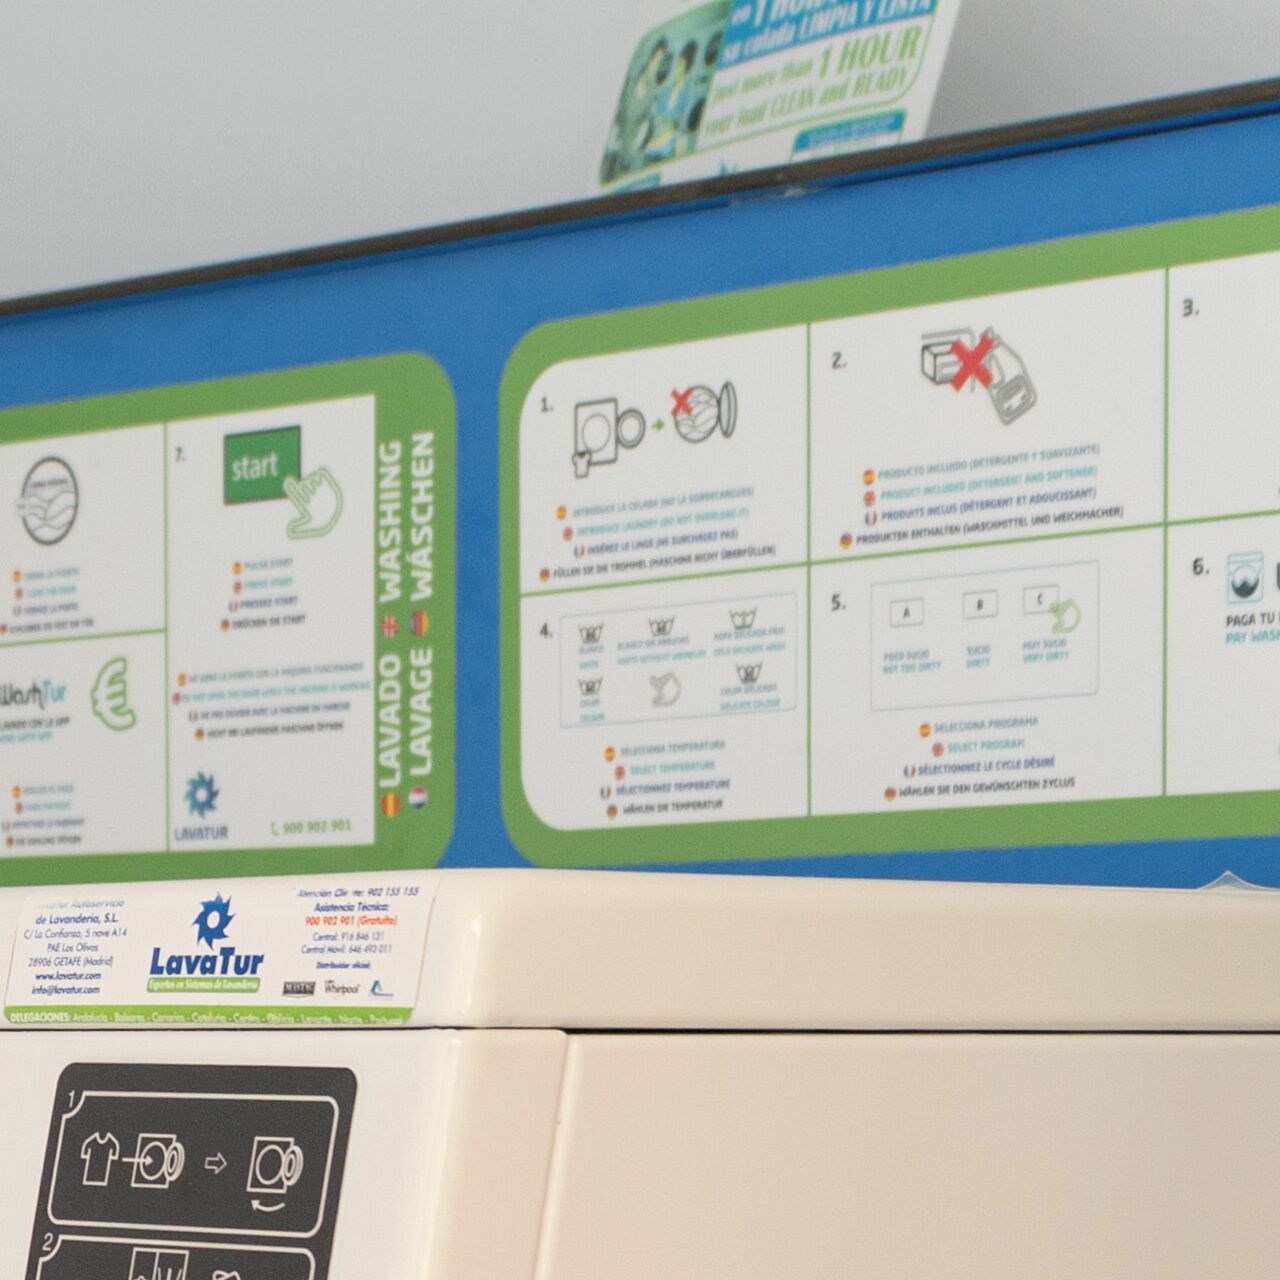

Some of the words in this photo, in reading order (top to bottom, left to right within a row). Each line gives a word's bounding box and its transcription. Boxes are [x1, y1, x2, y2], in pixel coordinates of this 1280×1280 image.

[820, 44, 832, 78] 1
[838, 25, 922, 74] HOUR
[832, 352, 846, 370] 2.
[231, 452, 278, 481] start
[379, 441, 401, 604] WASHING
[1192, 557, 1209, 575] 6.
[831, 593, 846, 612] 5.
[977, 599, 983, 612] B
[1227, 614, 1255, 627] PAGA
[1260, 612, 1275, 624] TU
[540, 622, 553, 638] 4.
[379, 653, 401, 787] LAVADO
[409, 646, 432, 776] LAVAGE
[175, 826, 228, 842] LAVATUR
[283, 821, 303, 835] 900
[307, 820, 328, 833] 902
[332, 819, 351, 832] 901
[36, 915, 46, 924] de
[47, 943, 60, 952] PAE
[62, 943, 73, 951] Los
[76, 942, 98, 951] Olivos
[53, 956, 81, 967] GETAFE
[83, 956, 113, 967] (Madrid)
[150, 947, 264, 975] LavaTur
[35, 971, 101, 980] www.lavatur.com
[31, 985, 100, 996] info@lavatur.com
[68, 1090, 75, 1108] 1
[42, 1233, 53, 1252] 2
